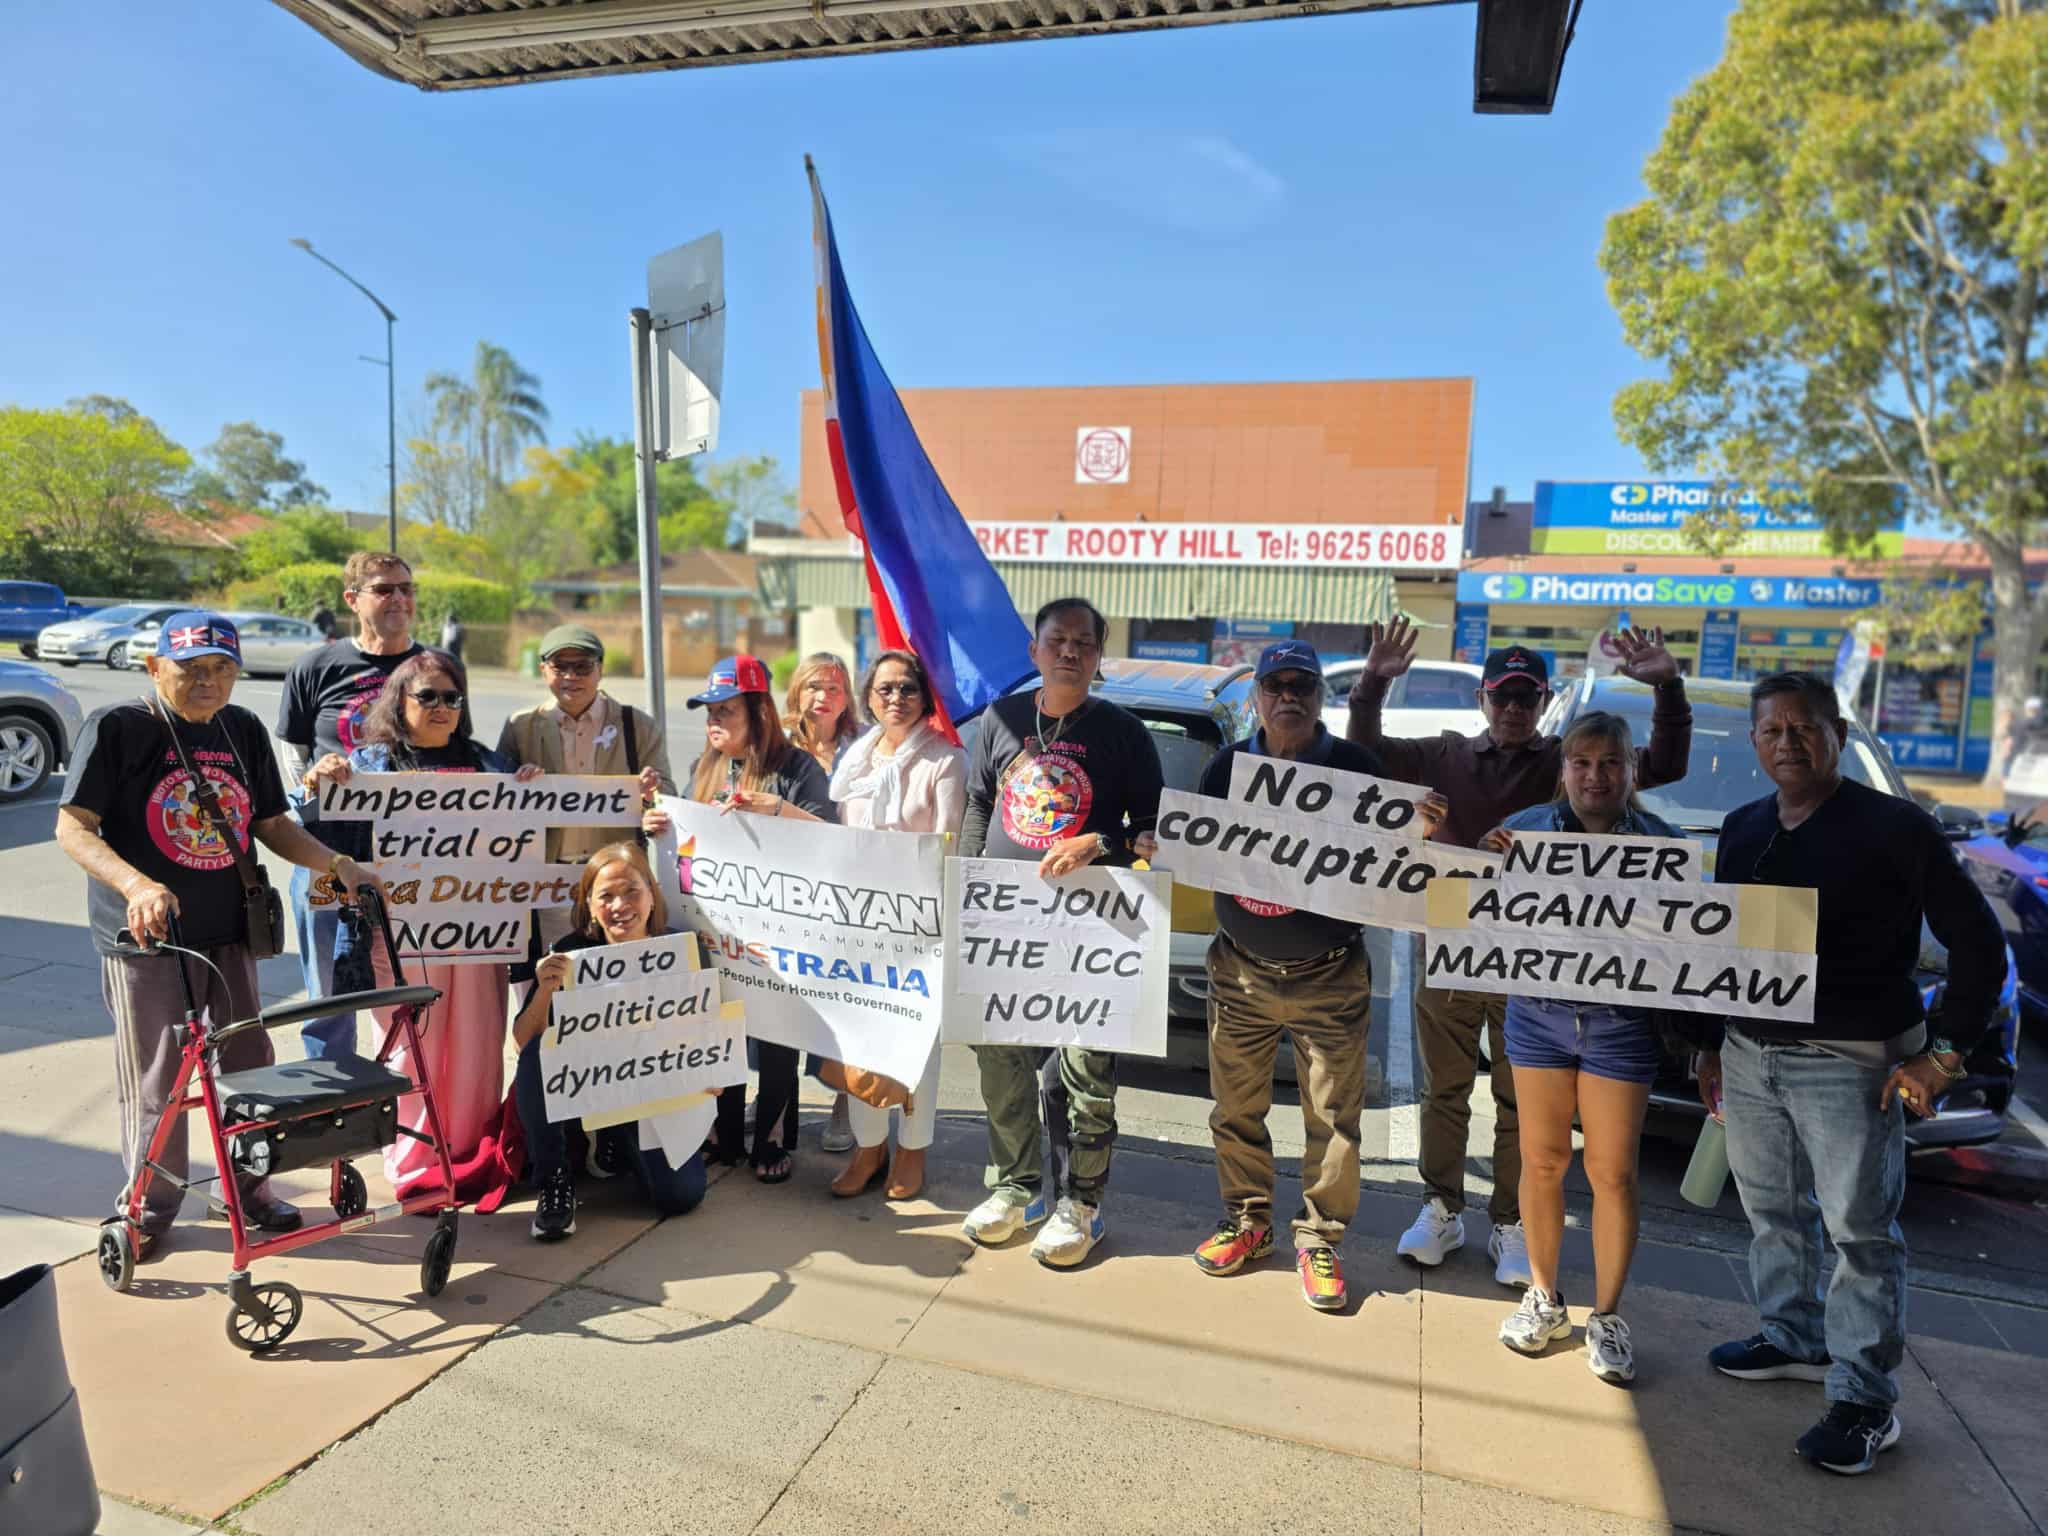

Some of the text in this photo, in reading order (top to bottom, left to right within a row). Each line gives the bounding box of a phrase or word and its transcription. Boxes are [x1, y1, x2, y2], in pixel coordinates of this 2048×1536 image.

[1610, 509, 1668, 524] Master
[975, 527, 1447, 562] RKET ROOTY HILL Tel: 9625 6068
[1531, 575, 1735, 603] PharmaSave
[1784, 580, 1875, 602] Master
[323, 782, 630, 818] Impeachment
[1244, 762, 1414, 830] No to
[378, 828, 536, 862] trial of
[1505, 839, 1689, 882] NEVER
[963, 881, 1145, 921] RE-JOIN
[1468, 888, 1732, 936] AGAIN TO
[398, 921, 520, 950] NOW!
[577, 949, 676, 984] No to
[964, 936, 1142, 977] THE ICC
[1428, 943, 1809, 1007] MARTIAL LAW
[557, 986, 711, 1044] political
[768, 973, 786, 993] for
[788, 982, 841, 1002] Honest
[842, 991, 923, 1022] Governance
[984, 992, 1112, 1027] NOW!
[546, 1038, 733, 1098] dynasties!
